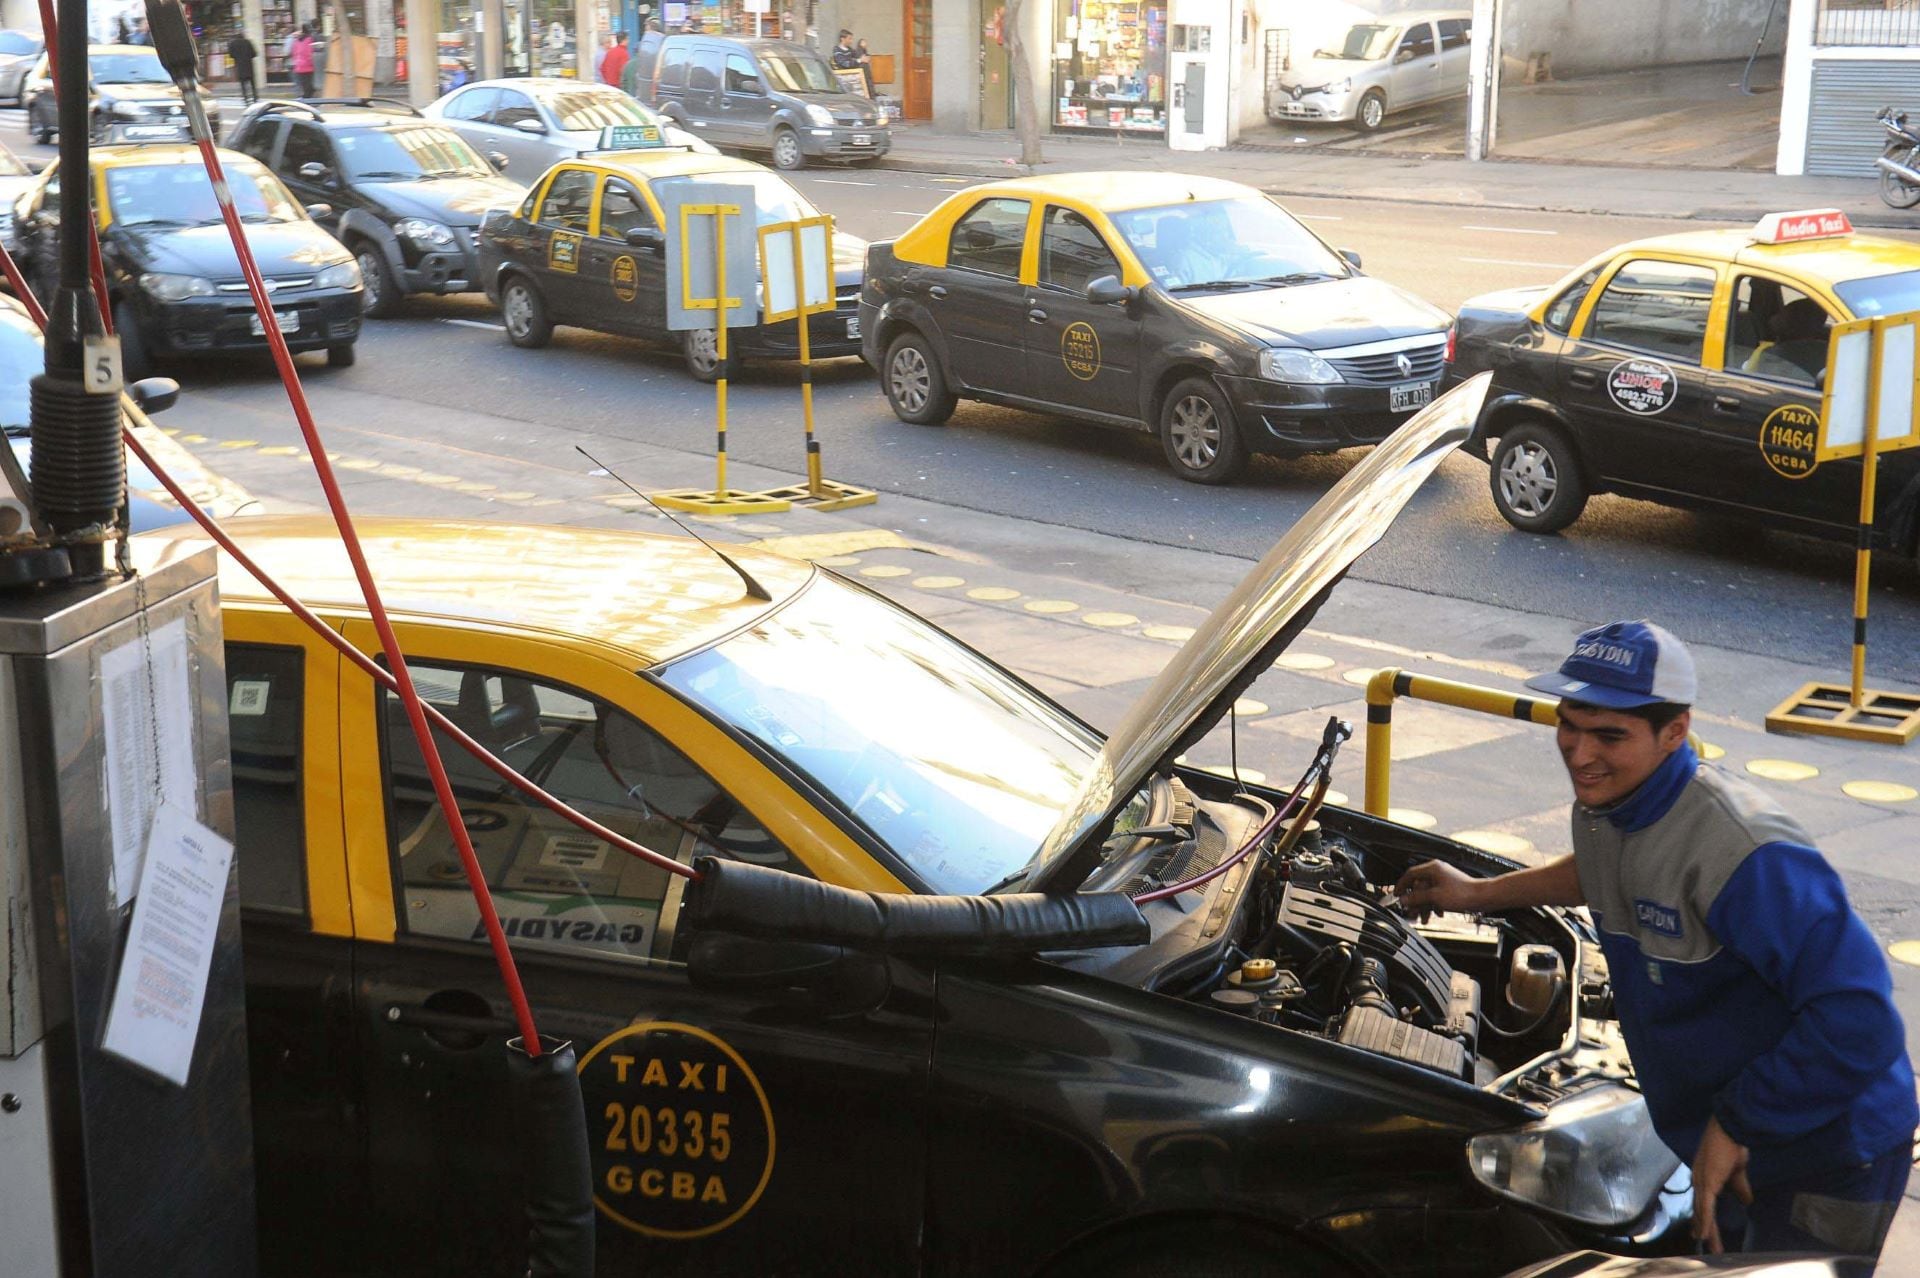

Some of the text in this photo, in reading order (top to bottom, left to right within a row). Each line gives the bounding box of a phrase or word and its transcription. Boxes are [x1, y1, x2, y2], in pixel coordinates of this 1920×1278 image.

[613, 132, 644, 141] TAXI
[1781, 213, 1844, 237] Radio Taxi
[1070, 330, 1090, 342] TAXI
[96, 356, 112, 384] 5
[1619, 371, 1663, 391] UNION
[1392, 391, 1409, 408] KFH
[1782, 410, 1812, 426] TAXI
[1771, 425, 1814, 452] 11464
[1772, 453, 1808, 470] GCBA
[610, 1055, 727, 1093] TAXI
[605, 1102, 731, 1162] 20335
[606, 1165, 727, 1204] GCBA
